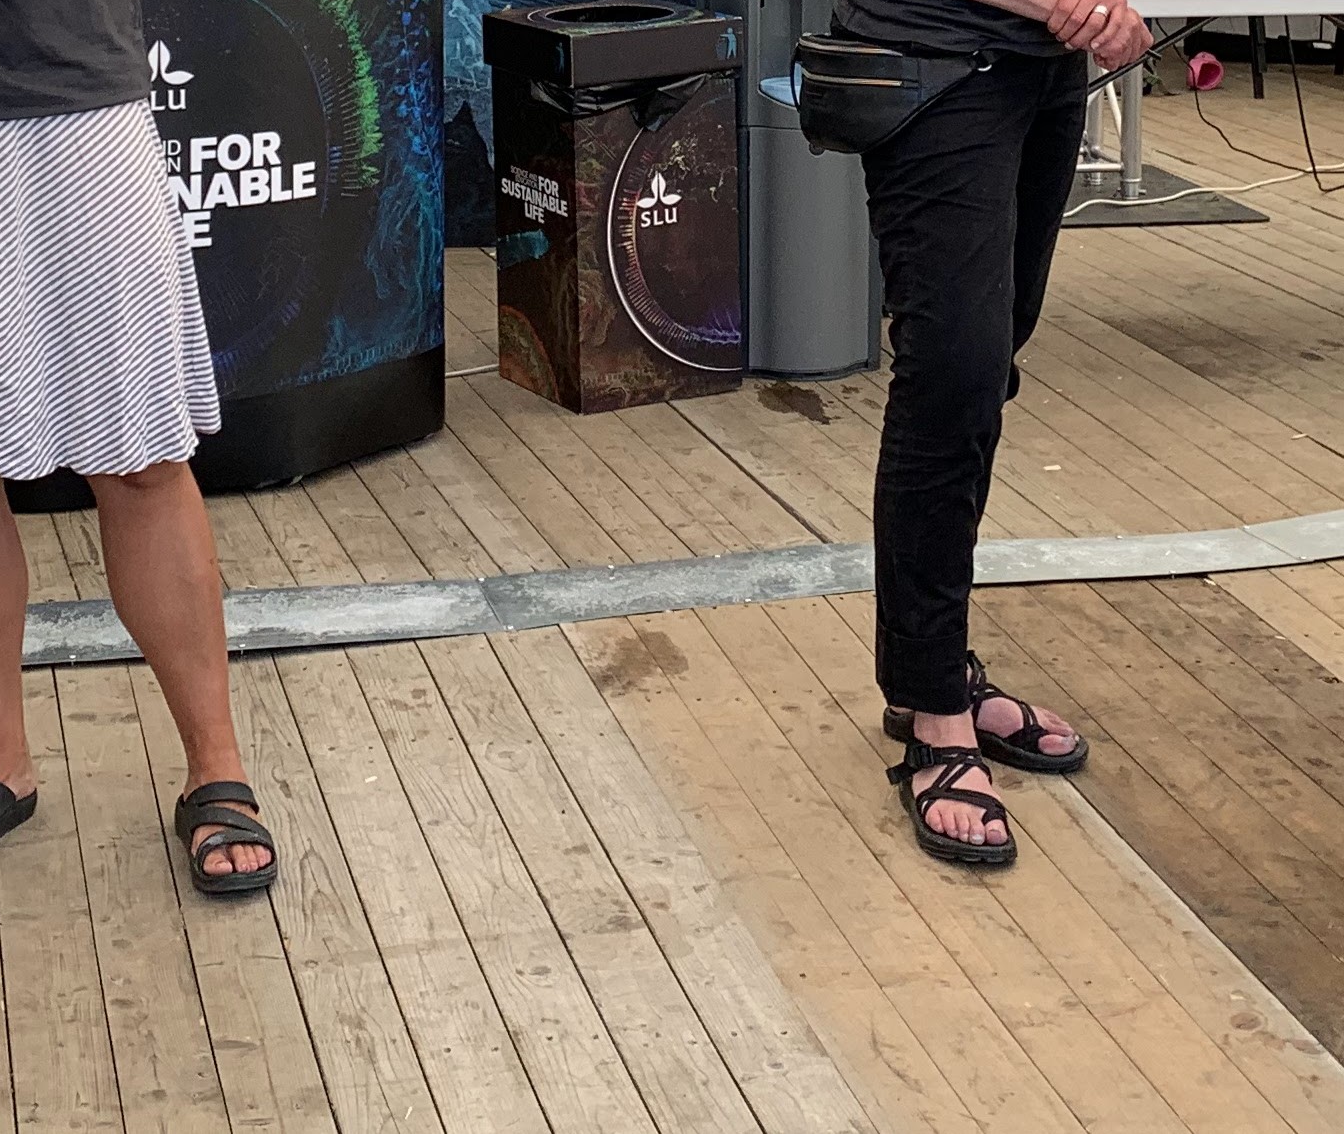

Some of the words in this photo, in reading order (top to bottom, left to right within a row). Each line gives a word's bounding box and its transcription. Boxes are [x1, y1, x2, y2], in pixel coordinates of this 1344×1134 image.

[150, 88, 187, 112] LU
[190, 131, 282, 173] FOR
[501, 177, 568, 217] SUSTAINABLE
[538, 175, 560, 198] FOR
[524, 202, 545, 224] LIFE
[640, 207, 677, 228] SLU
